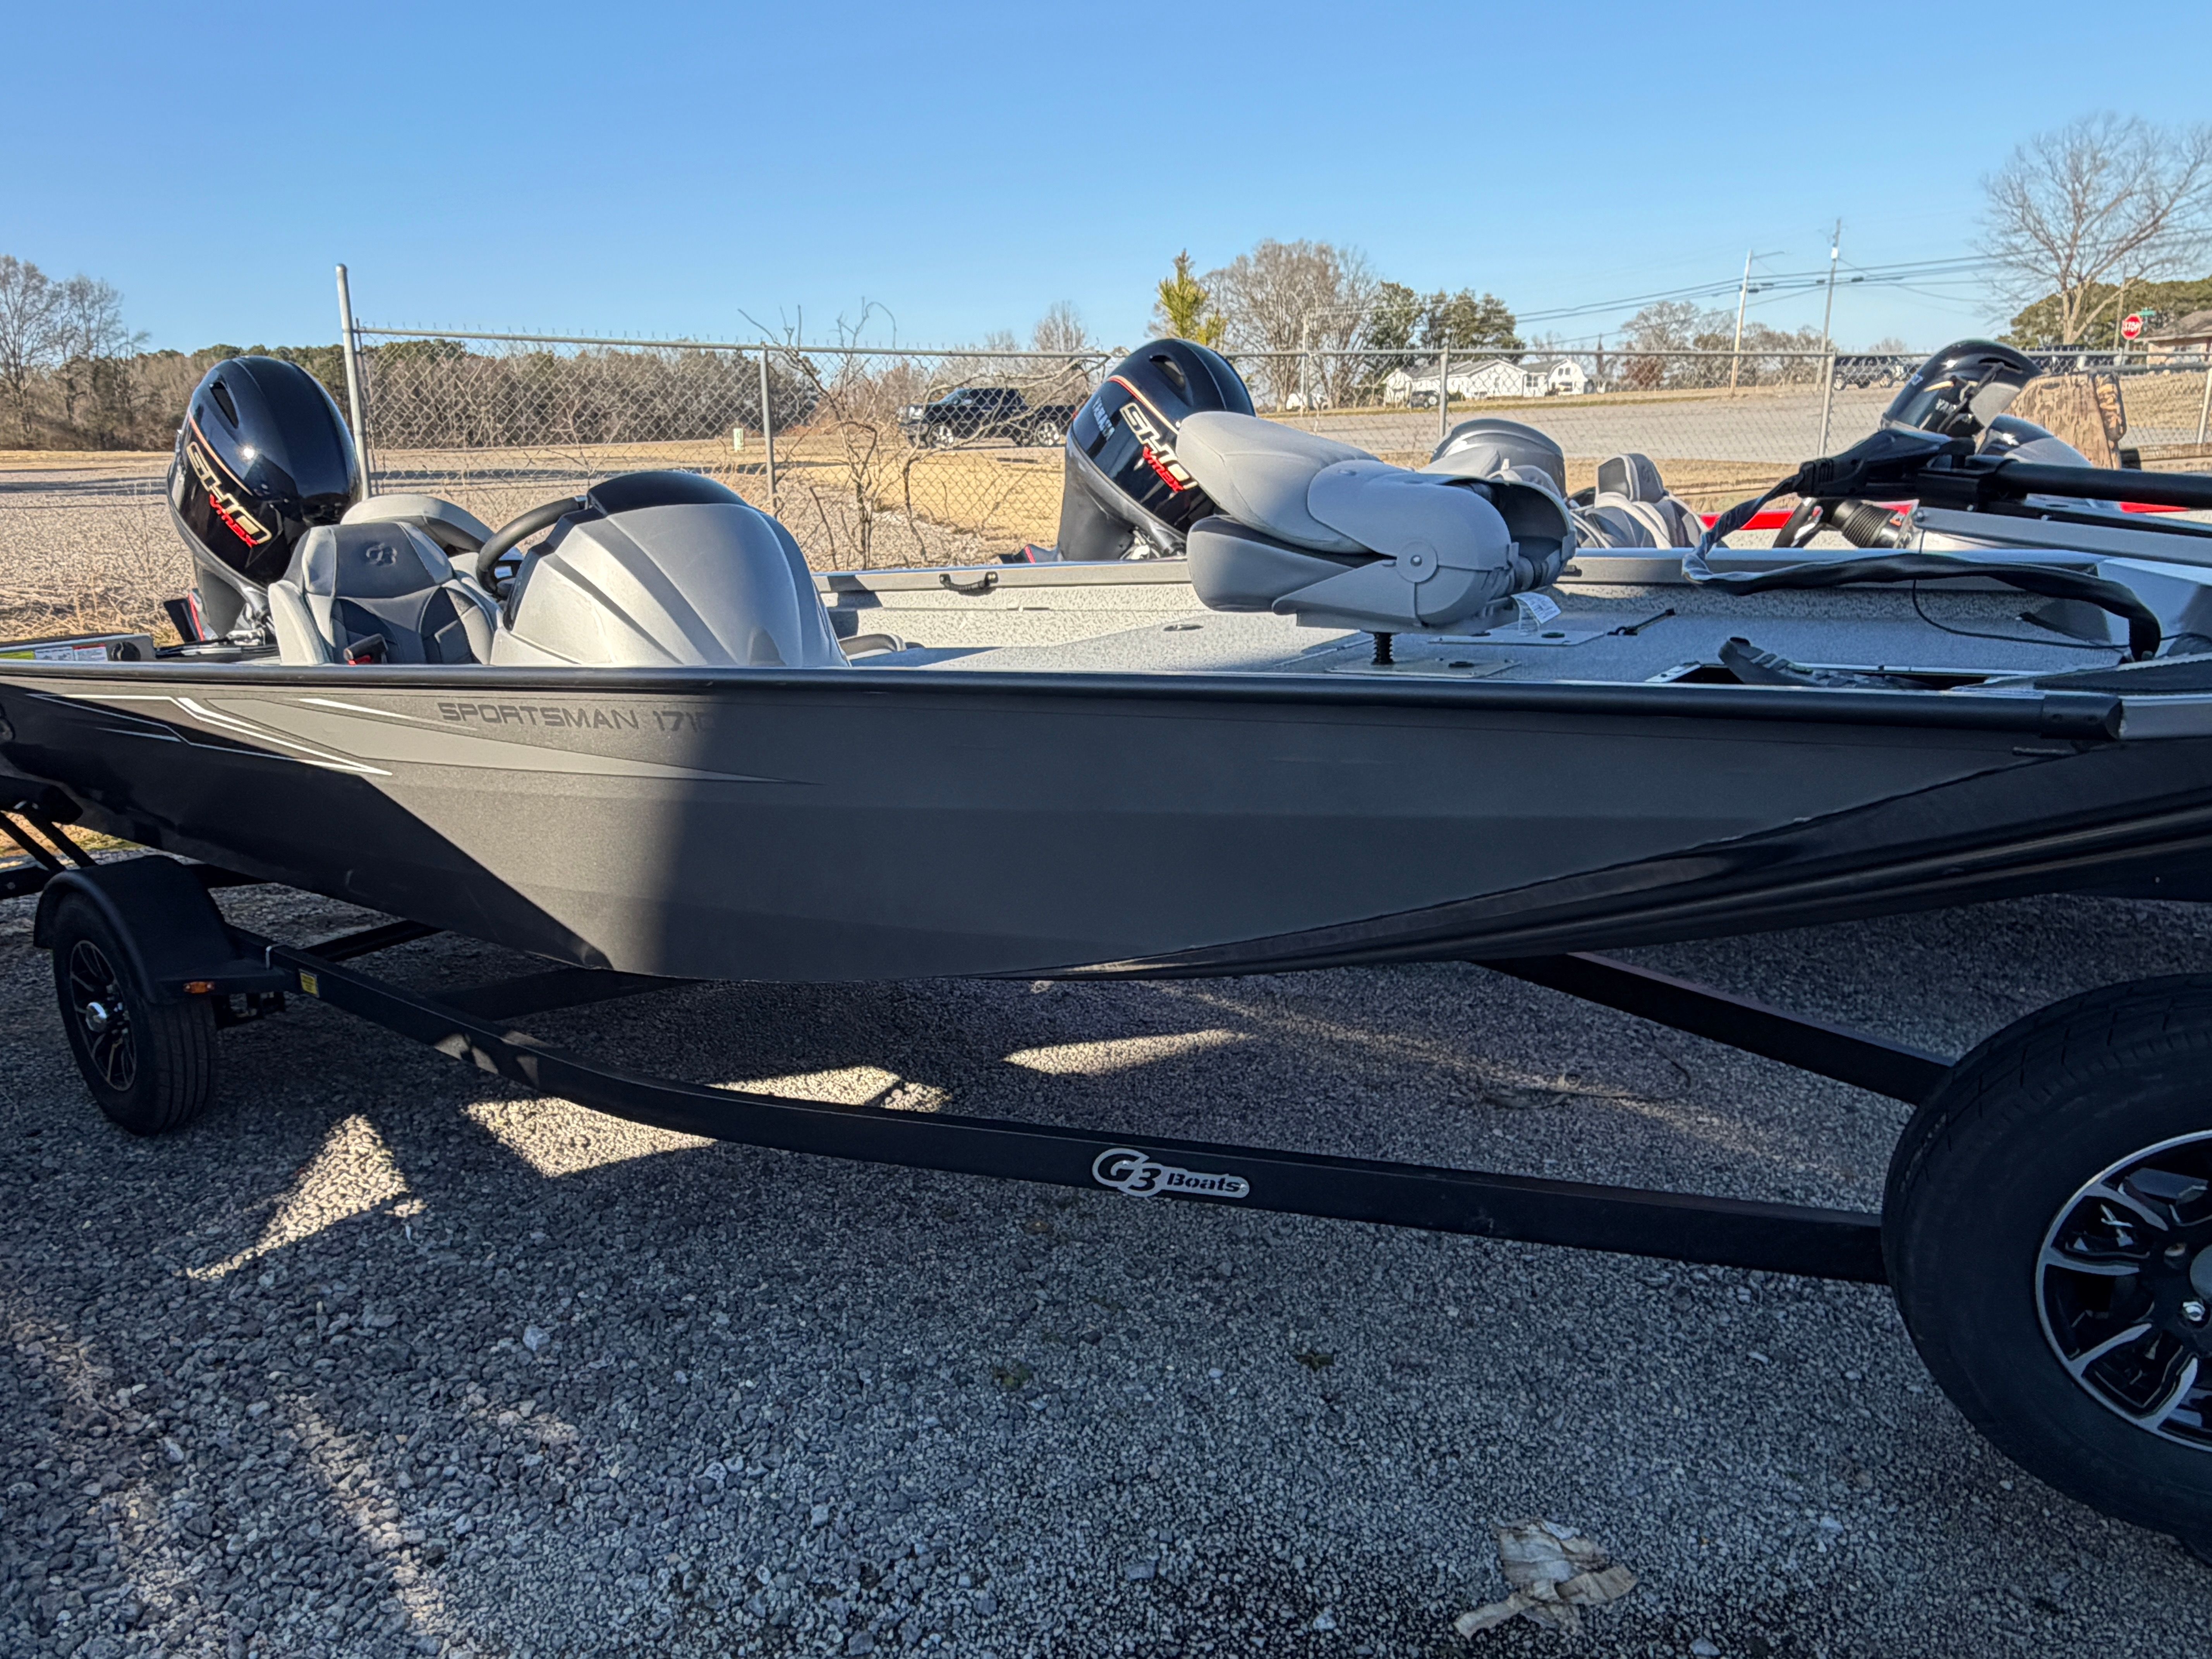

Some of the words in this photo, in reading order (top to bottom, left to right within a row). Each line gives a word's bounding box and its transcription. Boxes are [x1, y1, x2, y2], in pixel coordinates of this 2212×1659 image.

[2123, 321, 2140, 332] STOP
[1119, 402, 1198, 490] SHO
[186, 441, 273, 544] SHO
[438, 702, 639, 730] SPORTSMAN
[1097, 1152, 1162, 1192] G3
[1166, 1173, 1242, 1193] Boats
